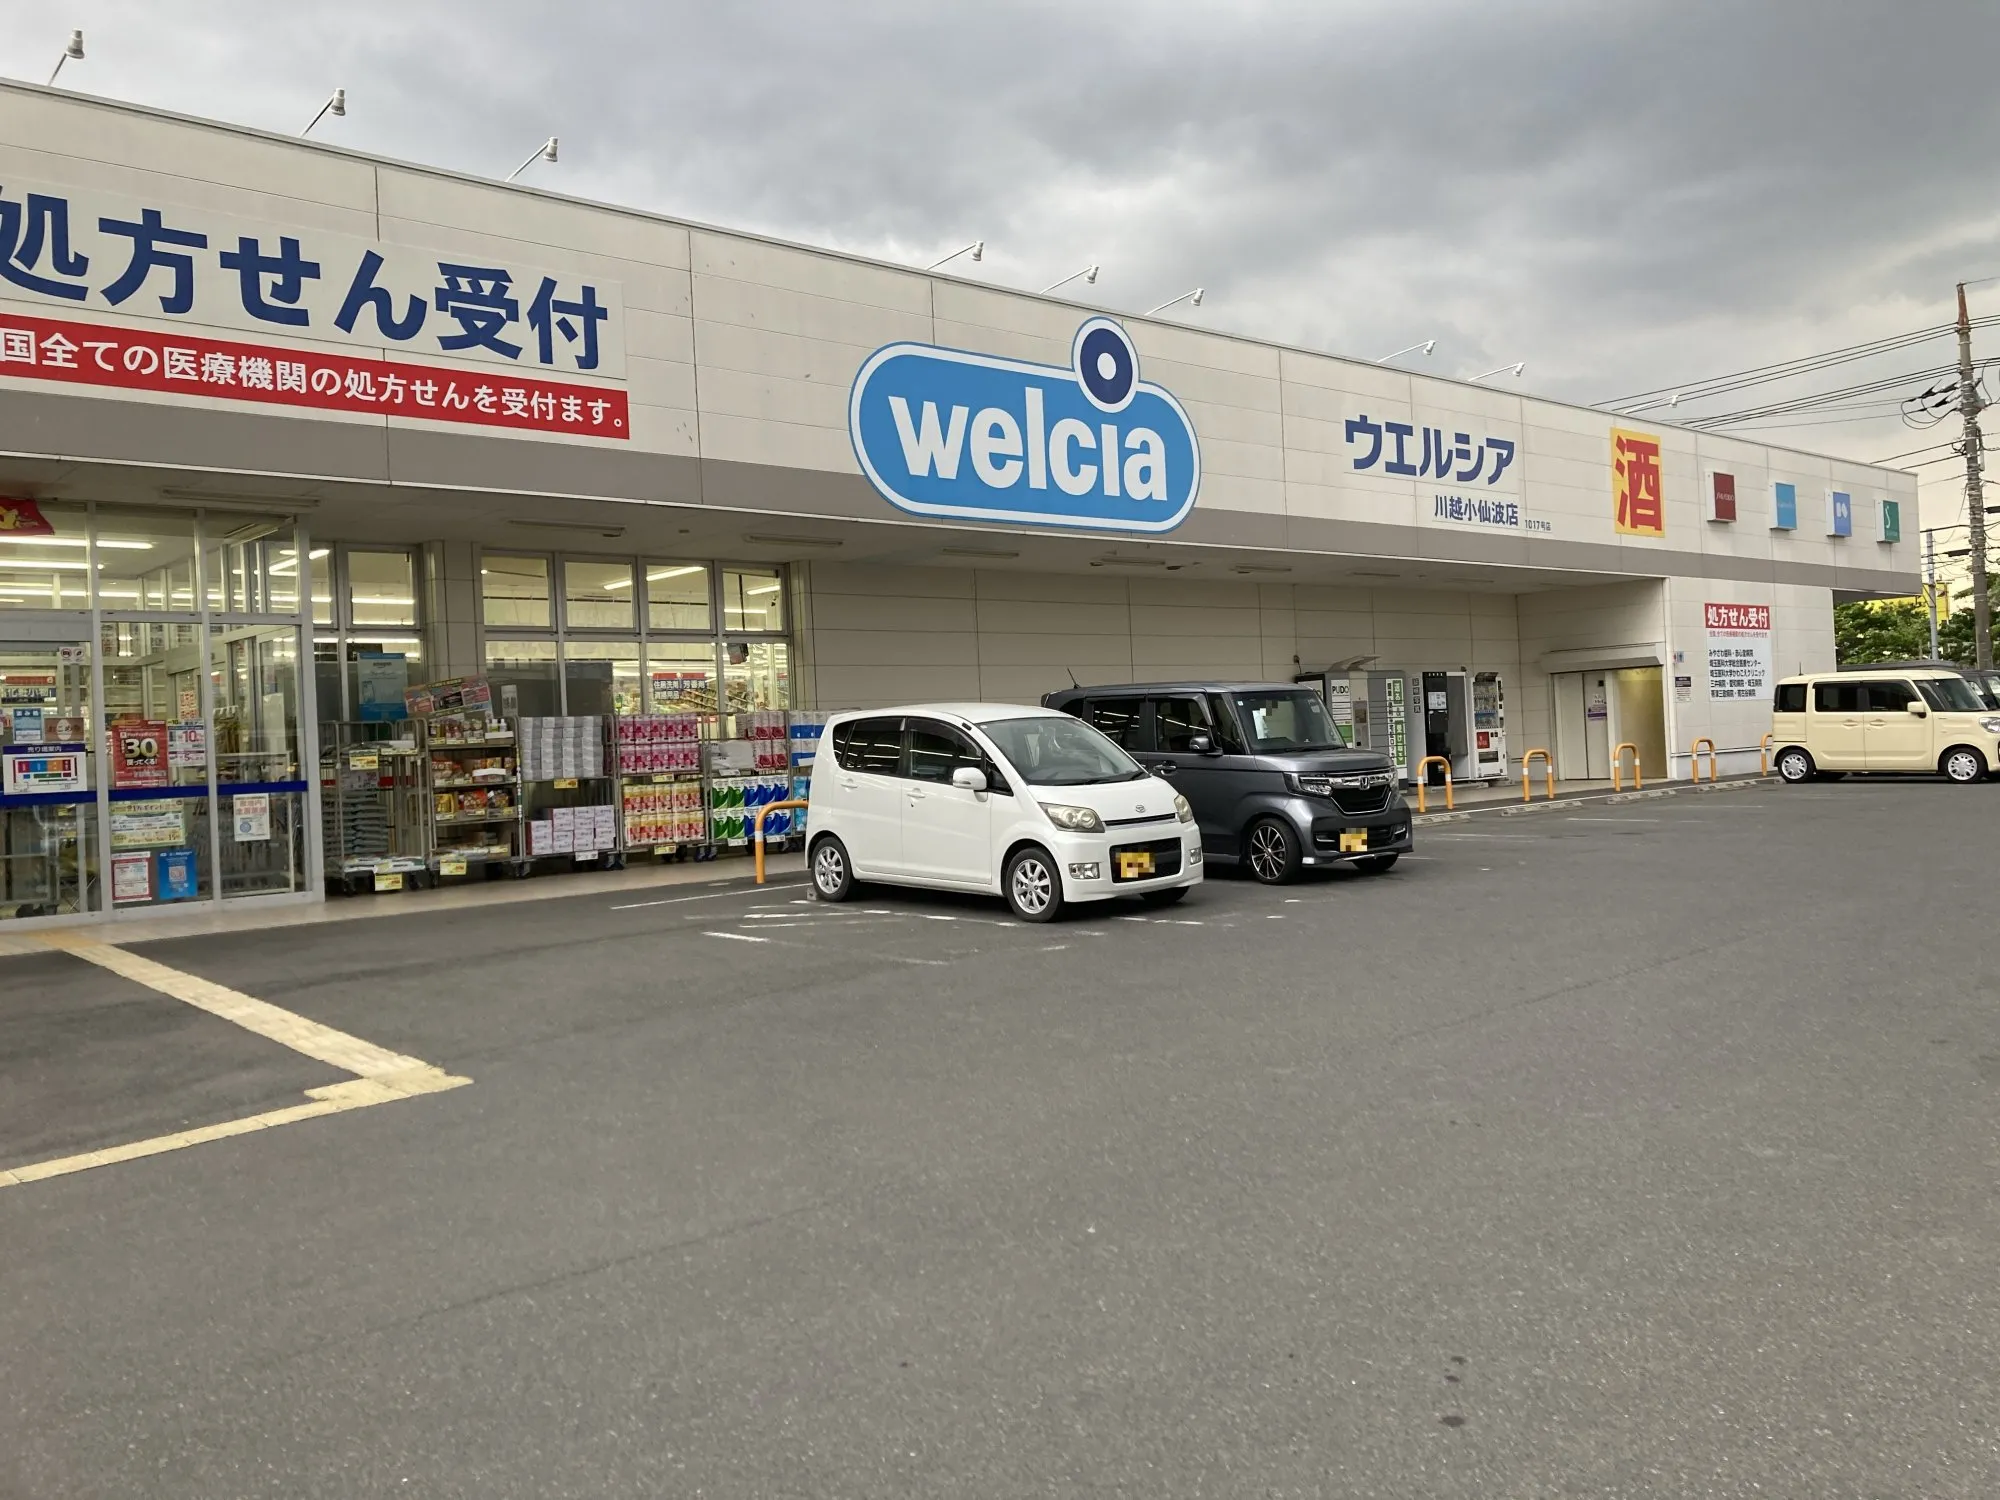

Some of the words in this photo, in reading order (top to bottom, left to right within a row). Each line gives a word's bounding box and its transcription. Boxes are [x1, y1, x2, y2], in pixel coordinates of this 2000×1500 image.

[0, 185, 608, 370] 処方せん受付
[0, 327, 623, 428] 国全ての医療機関の処方せんを受付ます。
[888, 386, 1168, 501] welcia
[1345, 414, 1515, 485] ウエルシア
[1615, 433, 1663, 532] 酒
[1434, 494, 1519, 526] 川越小仙波店
[1525, 519, 1551, 531] 1017号店
[1707, 605, 1769, 629] 処方せん受付
[1331, 685, 1350, 695] PUDO
